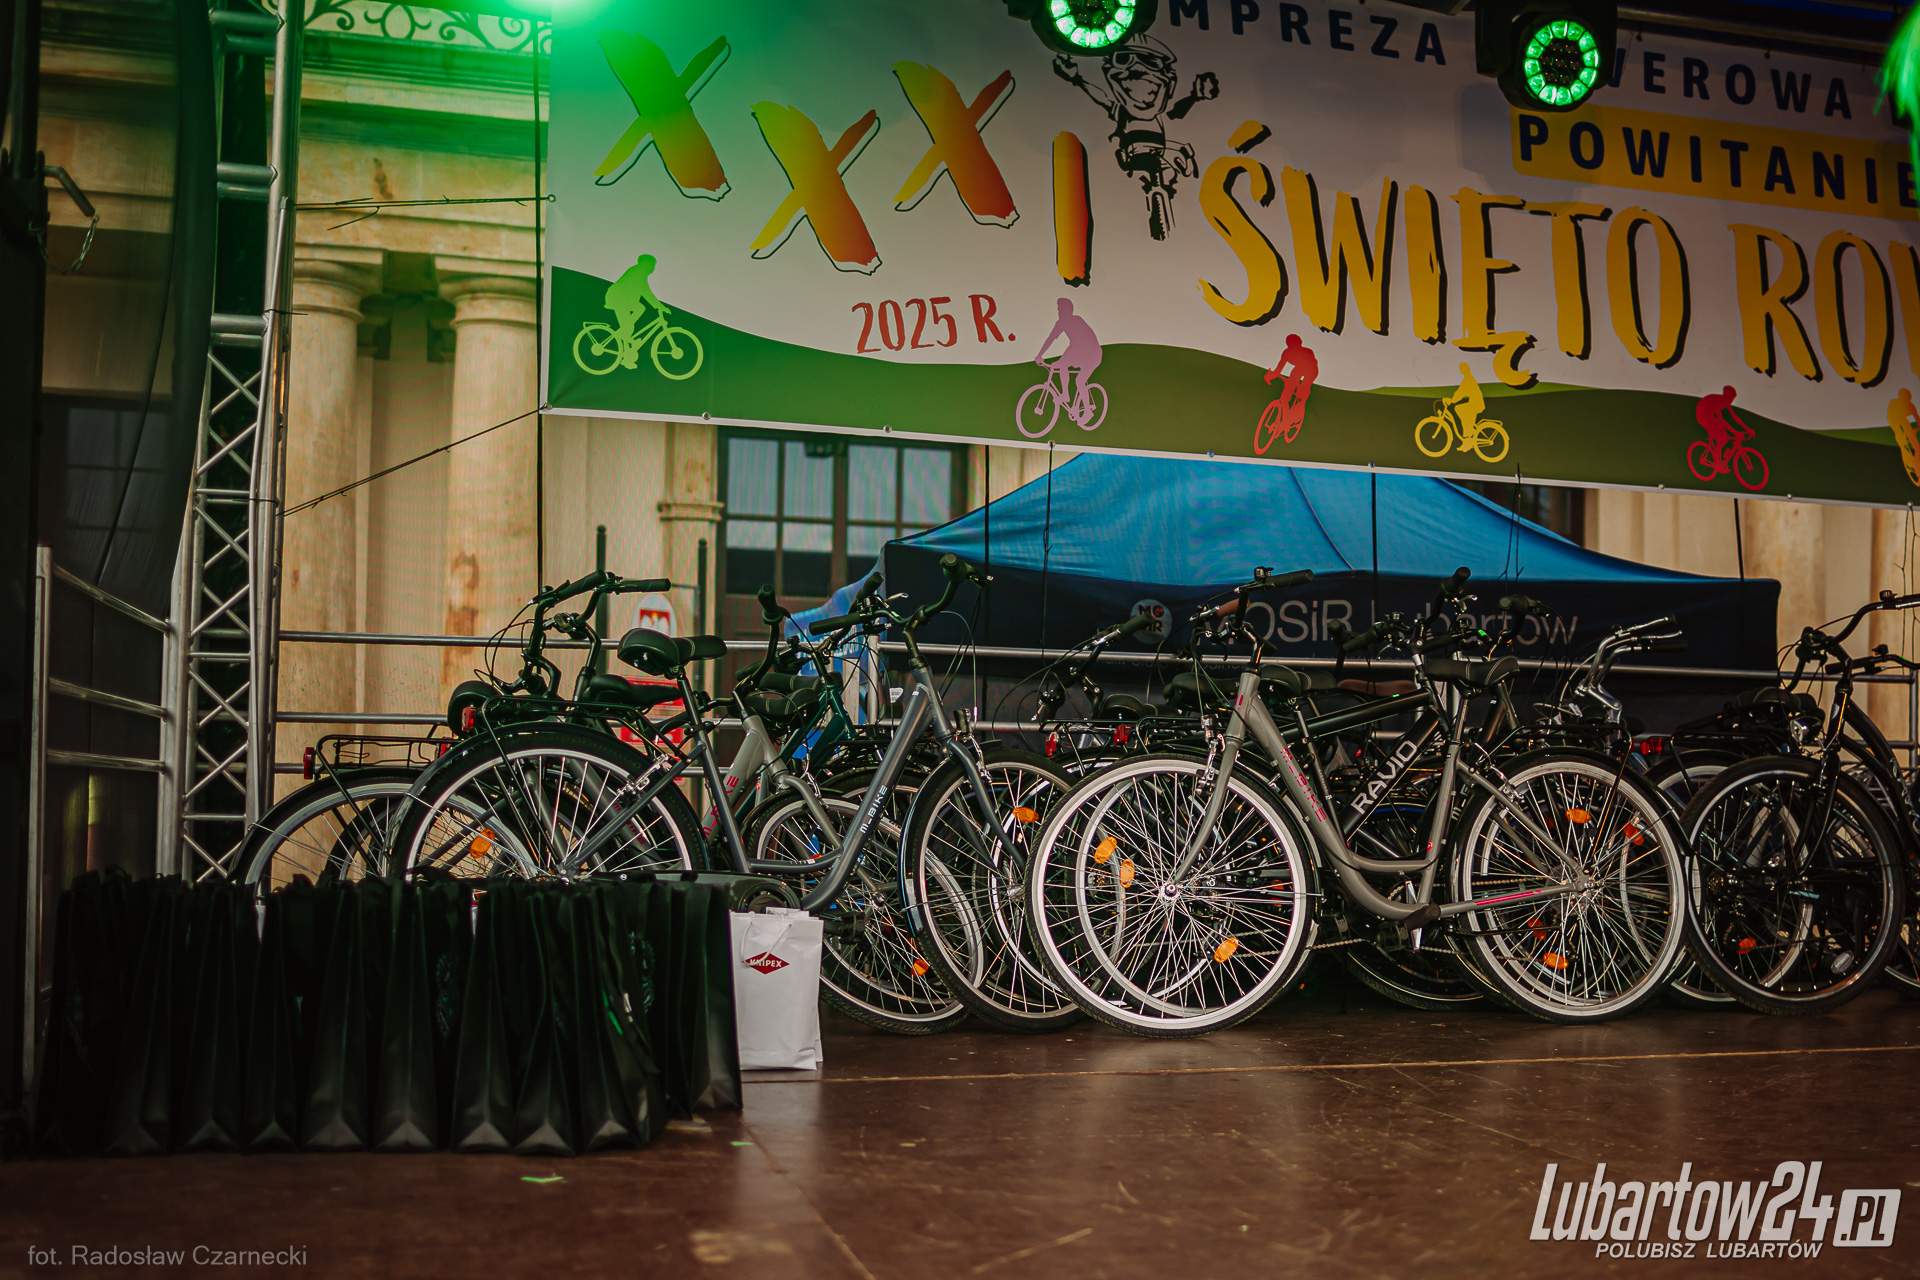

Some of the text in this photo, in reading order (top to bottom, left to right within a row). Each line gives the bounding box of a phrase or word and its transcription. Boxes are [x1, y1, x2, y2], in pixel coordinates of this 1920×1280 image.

[1168, 0, 1446, 66] MPREZA
[1519, 113, 1919, 208] POWITANIE
[1197, 119, 1691, 390] ŚWIĘTO
[1728, 222, 1920, 389] RO
[852, 294, 1016, 353] 2025 R.
[1350, 739, 1418, 815] RAVIO
